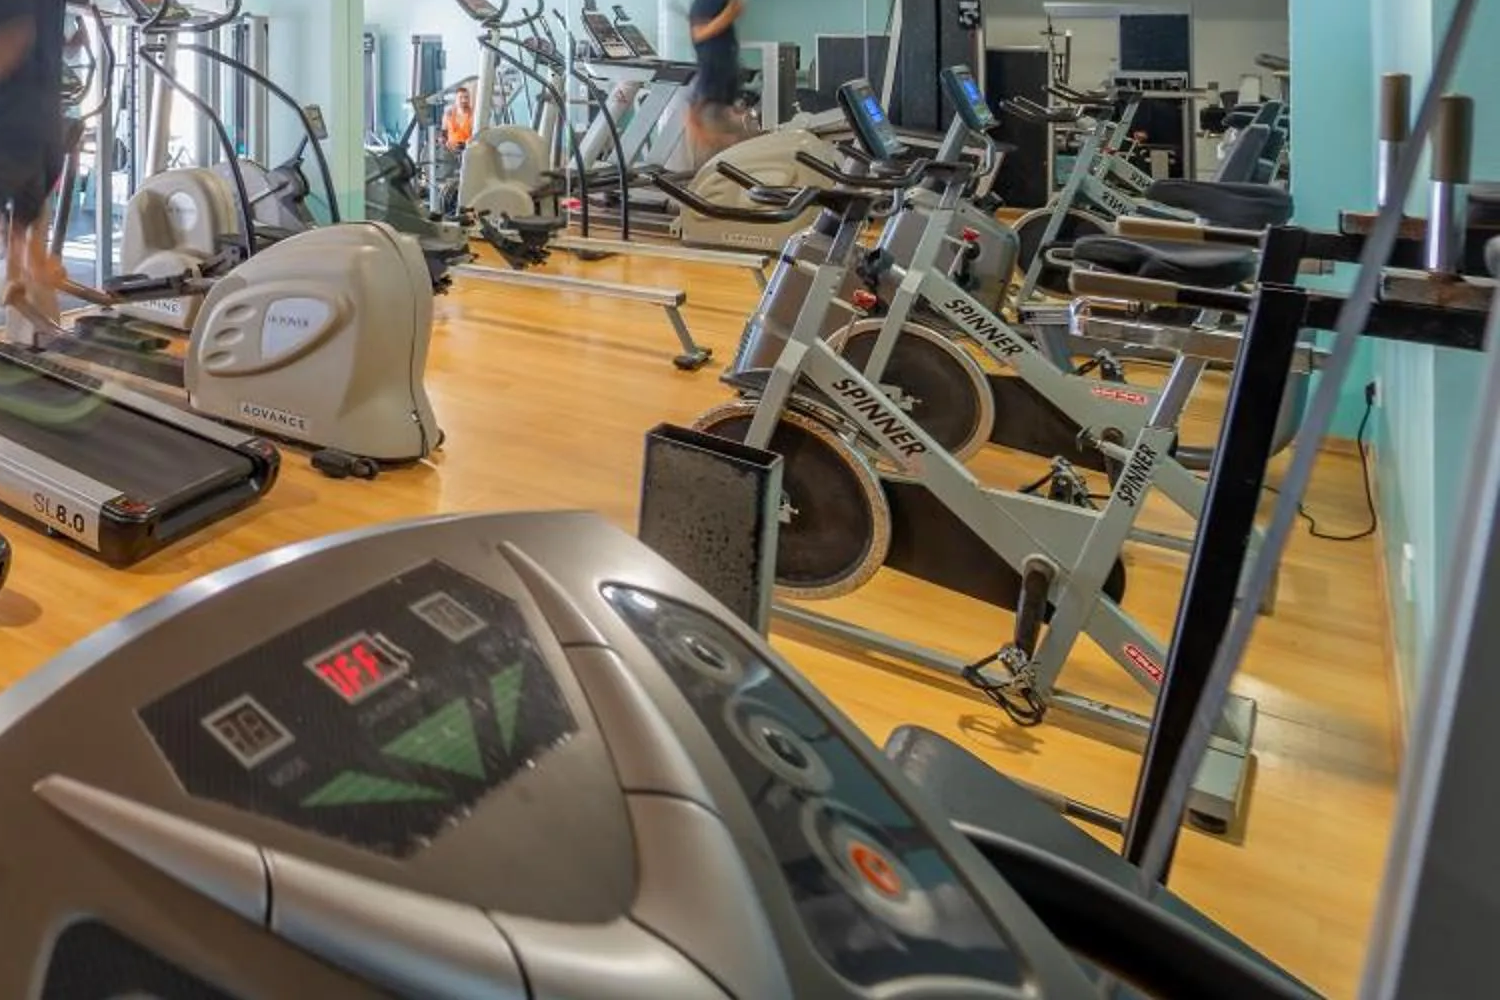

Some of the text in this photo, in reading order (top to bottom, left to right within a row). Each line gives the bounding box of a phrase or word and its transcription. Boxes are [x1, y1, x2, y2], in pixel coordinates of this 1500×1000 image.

[944, 299, 1024, 356] SPINNER
[243, 406, 306, 430] ADVANCE
[832, 379, 927, 458] SPINNER
[1117, 443, 1158, 507] SPINNER
